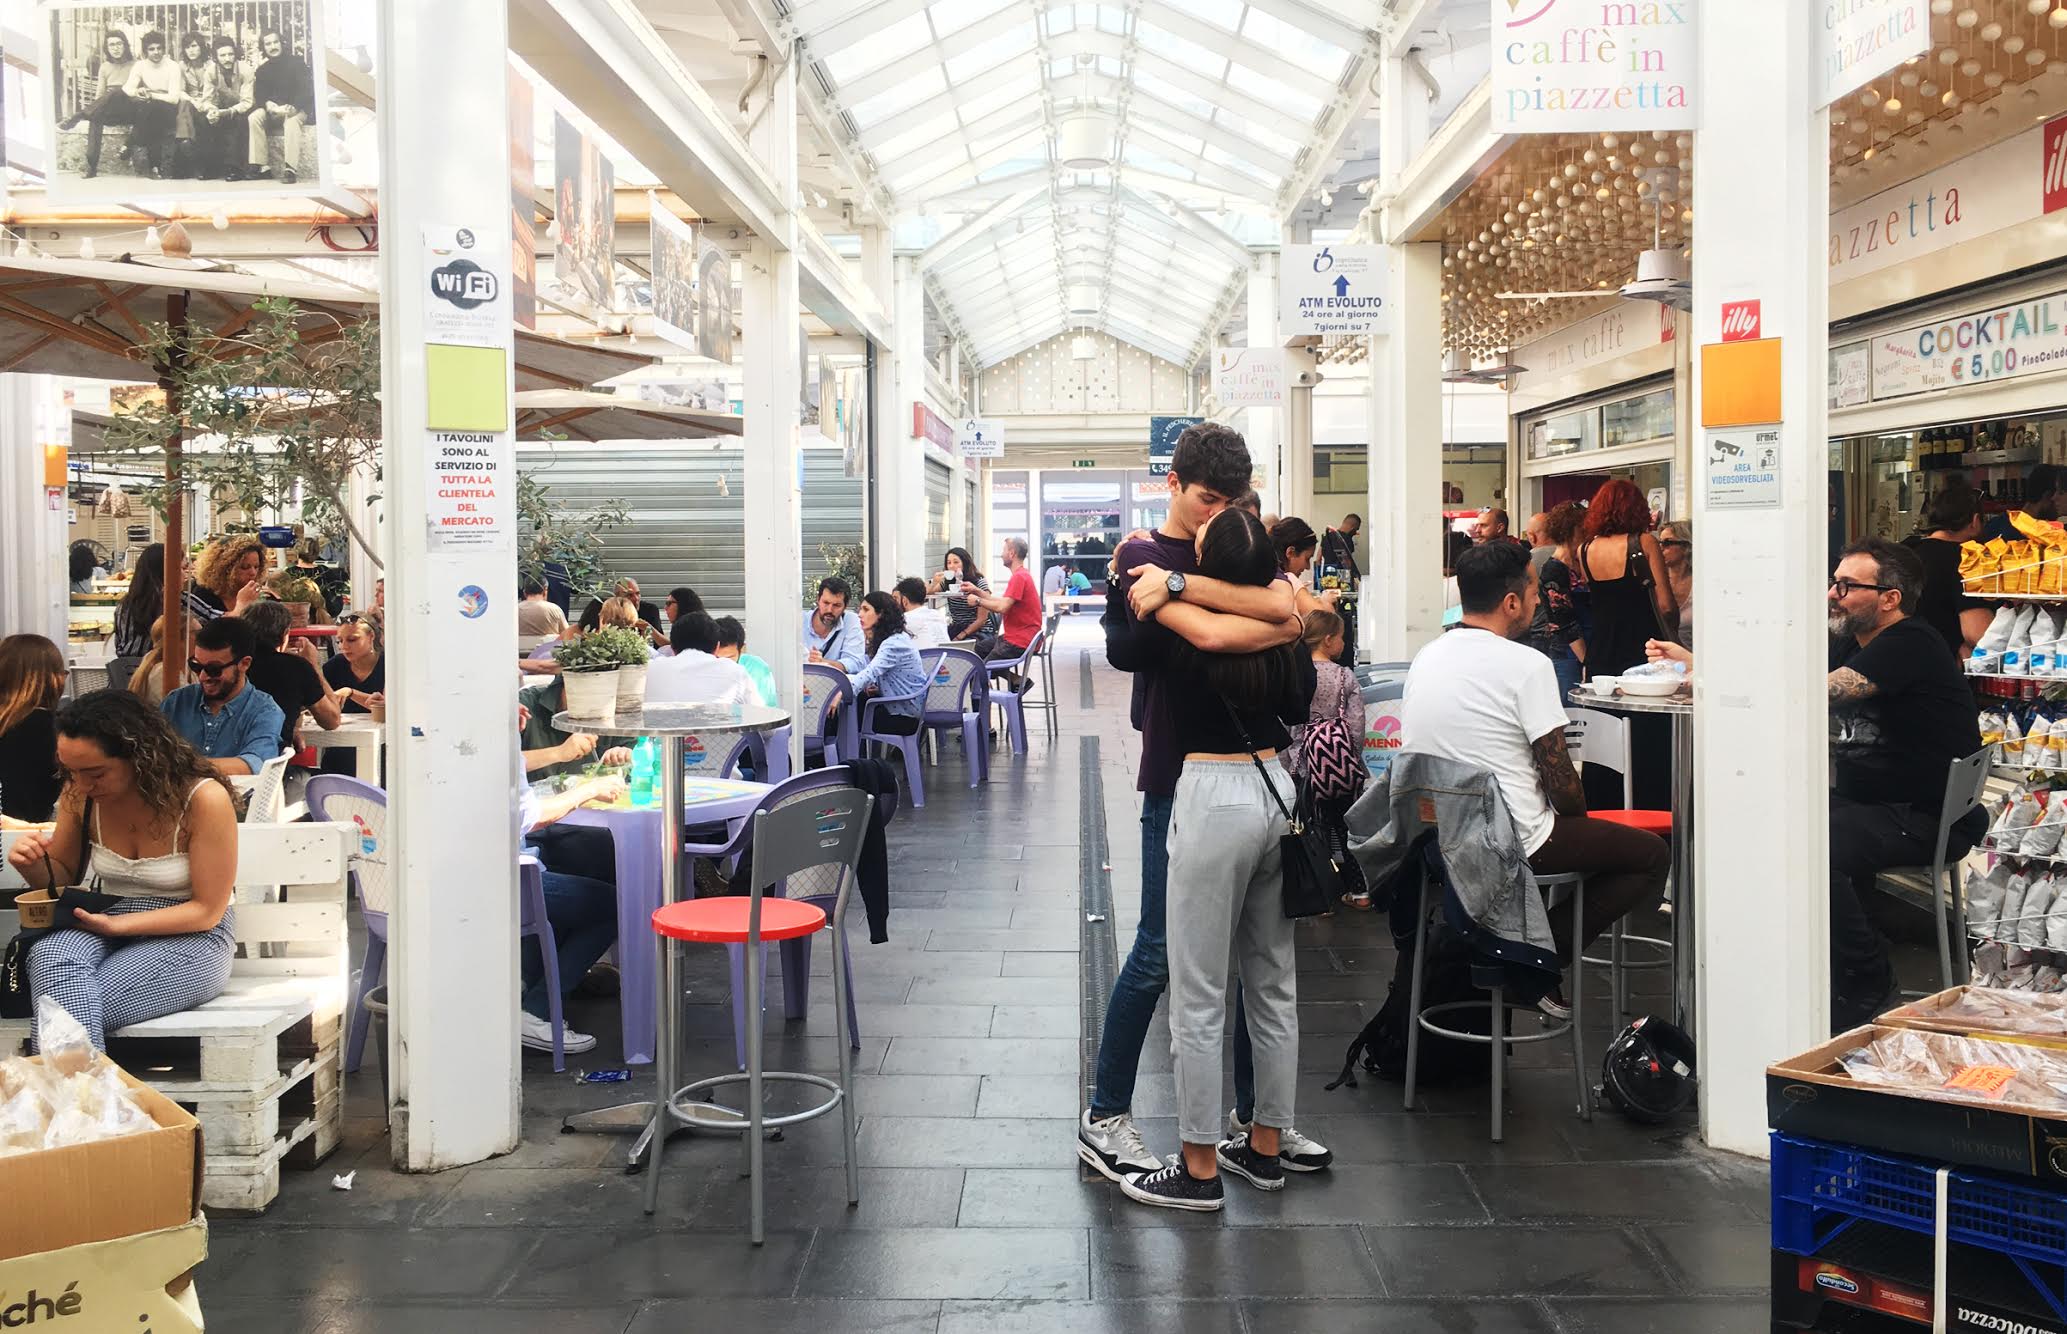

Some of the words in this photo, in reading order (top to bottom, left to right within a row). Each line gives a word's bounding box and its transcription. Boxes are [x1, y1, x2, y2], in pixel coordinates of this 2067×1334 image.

[1601, 1, 1688, 26] max
[1505, 28, 1617, 65] caffè
[1629, 37, 1665, 72] in
[1507, 76, 1688, 122] piazzetta
[1299, 297, 1323, 308] ATM
[1327, 297, 1382, 308] EVOLUTO
[1302, 310, 1314, 318] 24
[1335, 310, 1345, 318] al
[1347, 310, 1378, 319] giorno
[1723, 306, 1758, 338] illy
[1919, 303, 2058, 357] COCKTAIL
[1971, 348, 2016, 379] 5,00
[442, 433, 494, 443] TAVOLINI
[442, 447, 473, 457] SONO
[475, 448, 490, 457] AL
[435, 461, 484, 471] SERVIZIO
[486, 462, 497, 471] DI
[1733, 463, 1752, 473] AREA
[441, 475, 476, 484] TUTTA
[478, 475, 492, 484] LA
[1711, 473, 1775, 485] VIDEOSORVEGLIATA
[438, 489, 496, 498] CLIENTELA
[457, 503, 478, 512] DEL
[441, 517, 494, 526] MERCATO
[0, 1280, 82, 1329] ché
